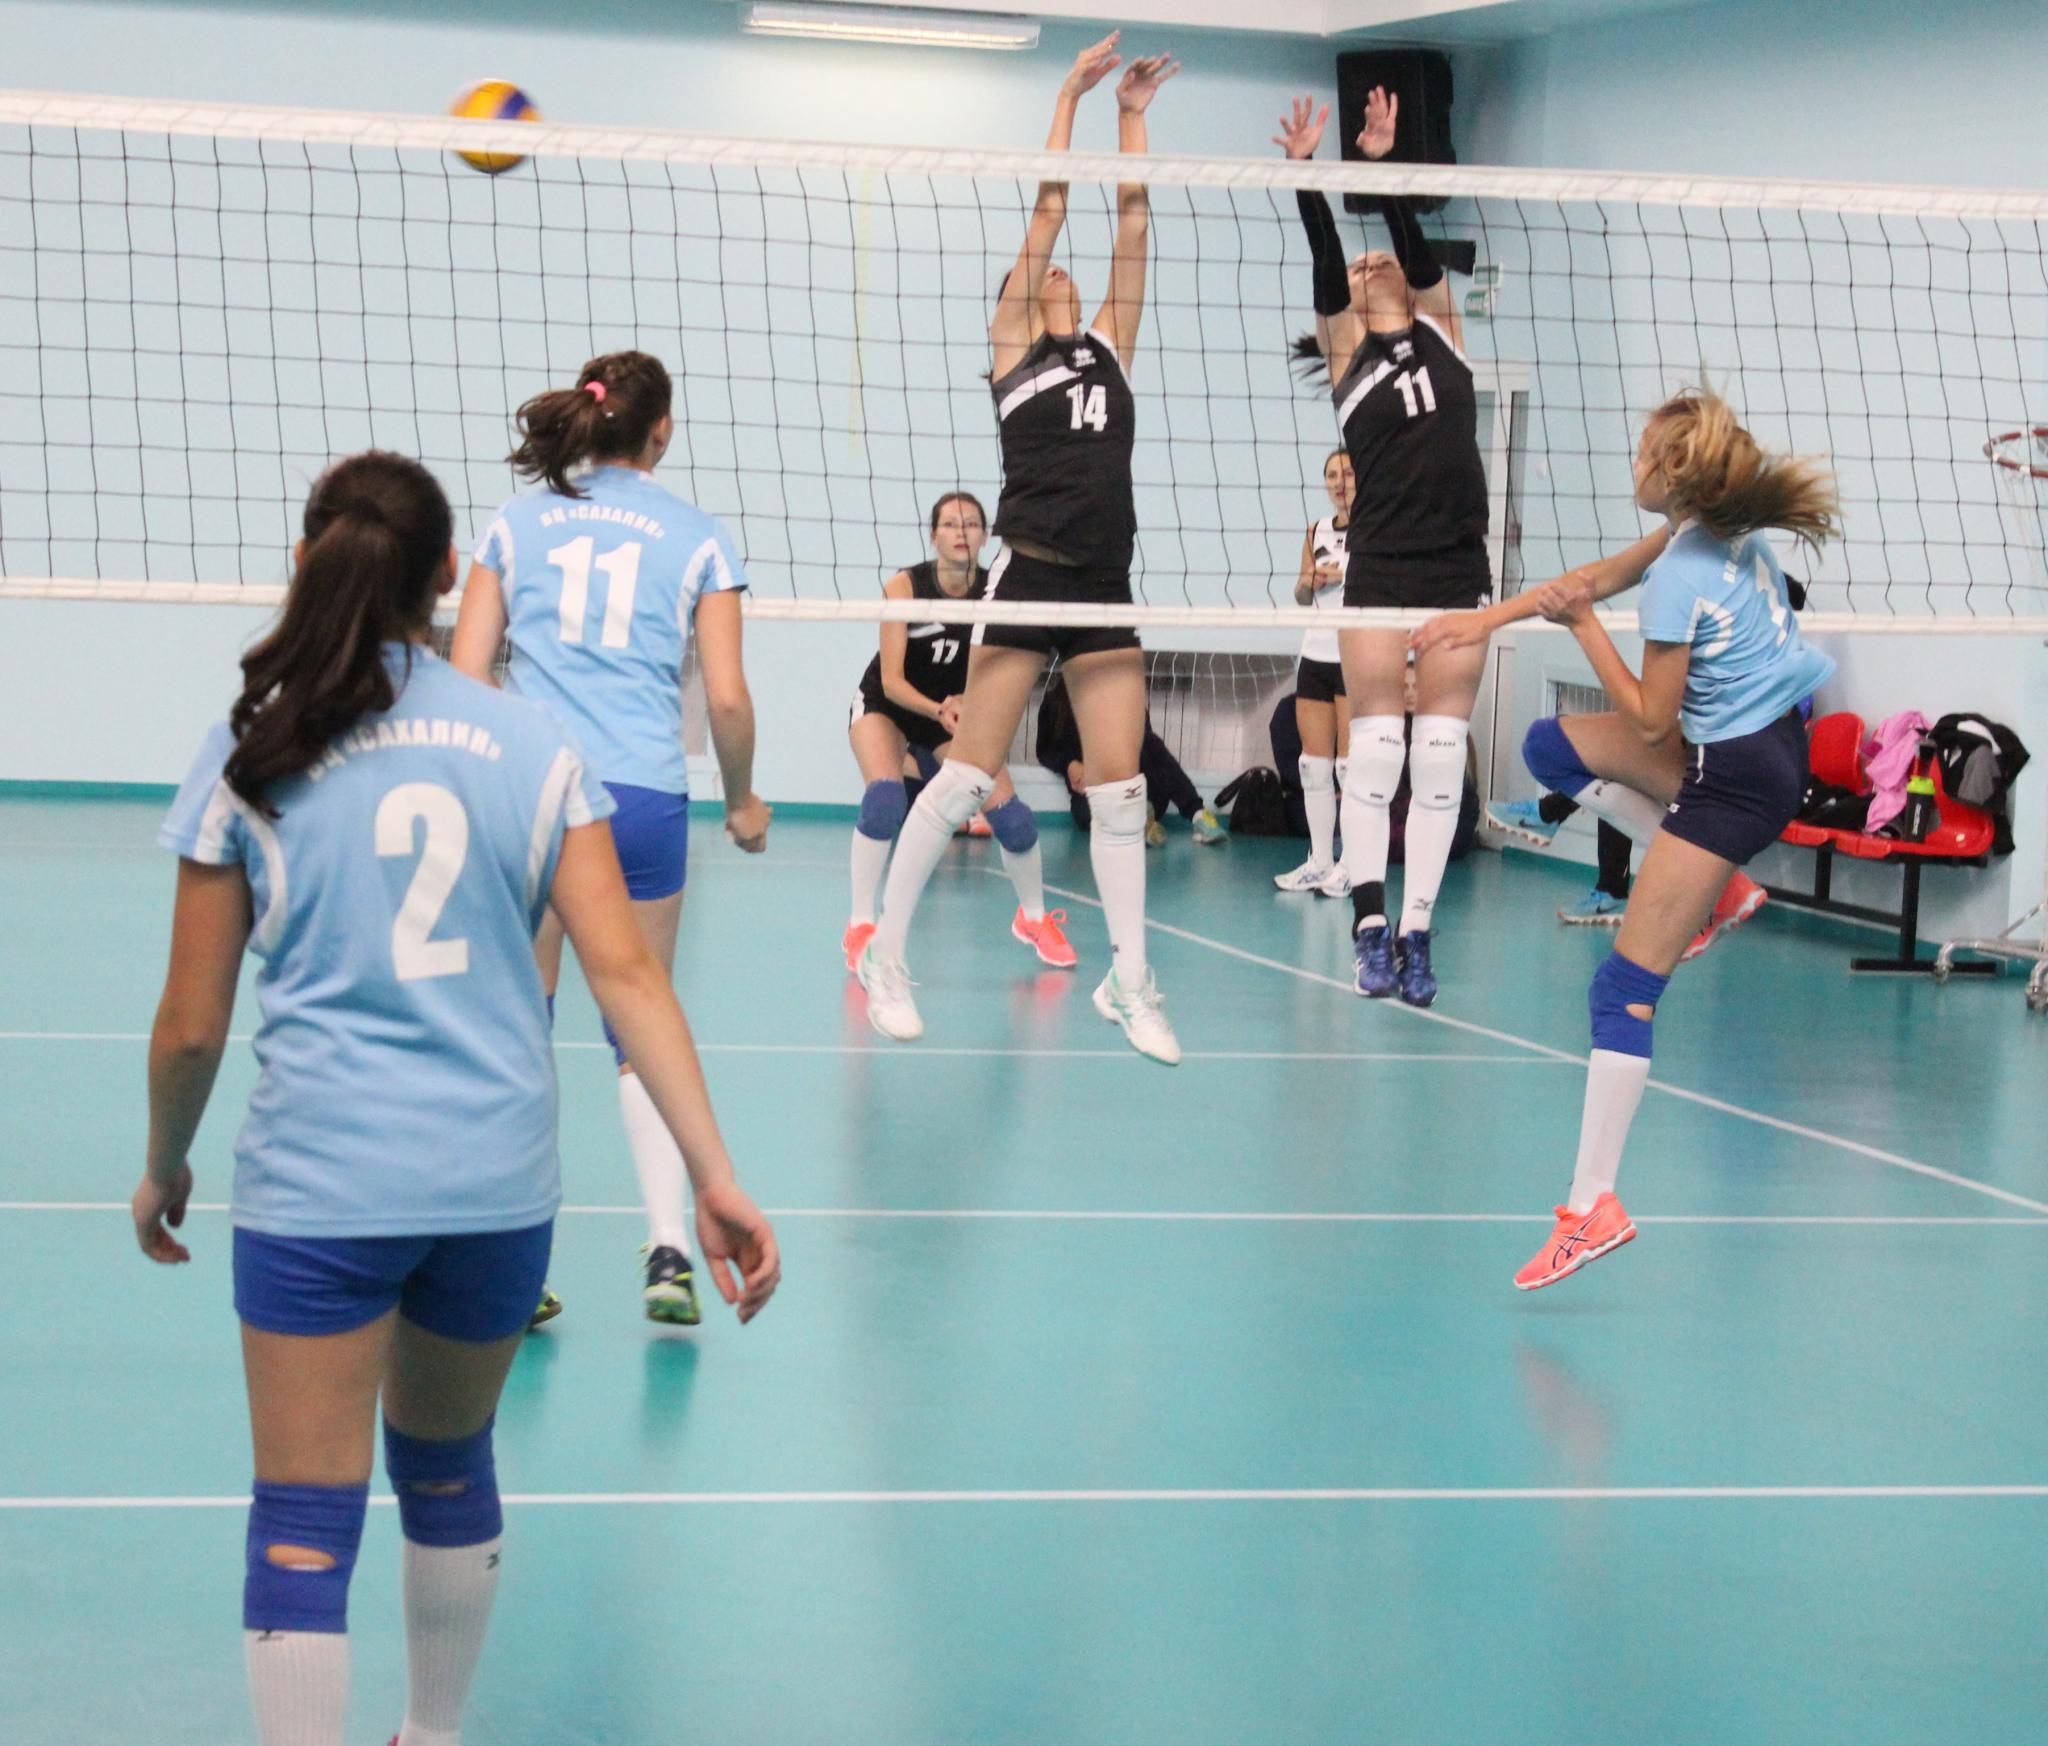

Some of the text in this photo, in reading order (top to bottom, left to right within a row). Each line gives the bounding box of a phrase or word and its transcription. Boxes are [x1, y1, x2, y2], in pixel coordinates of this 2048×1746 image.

[1065, 383, 1108, 432] 14
[1393, 365, 1437, 418] 11
[547, 535, 643, 649] 11
[931, 638, 960, 664] 17
[374, 782, 469, 982] 2
